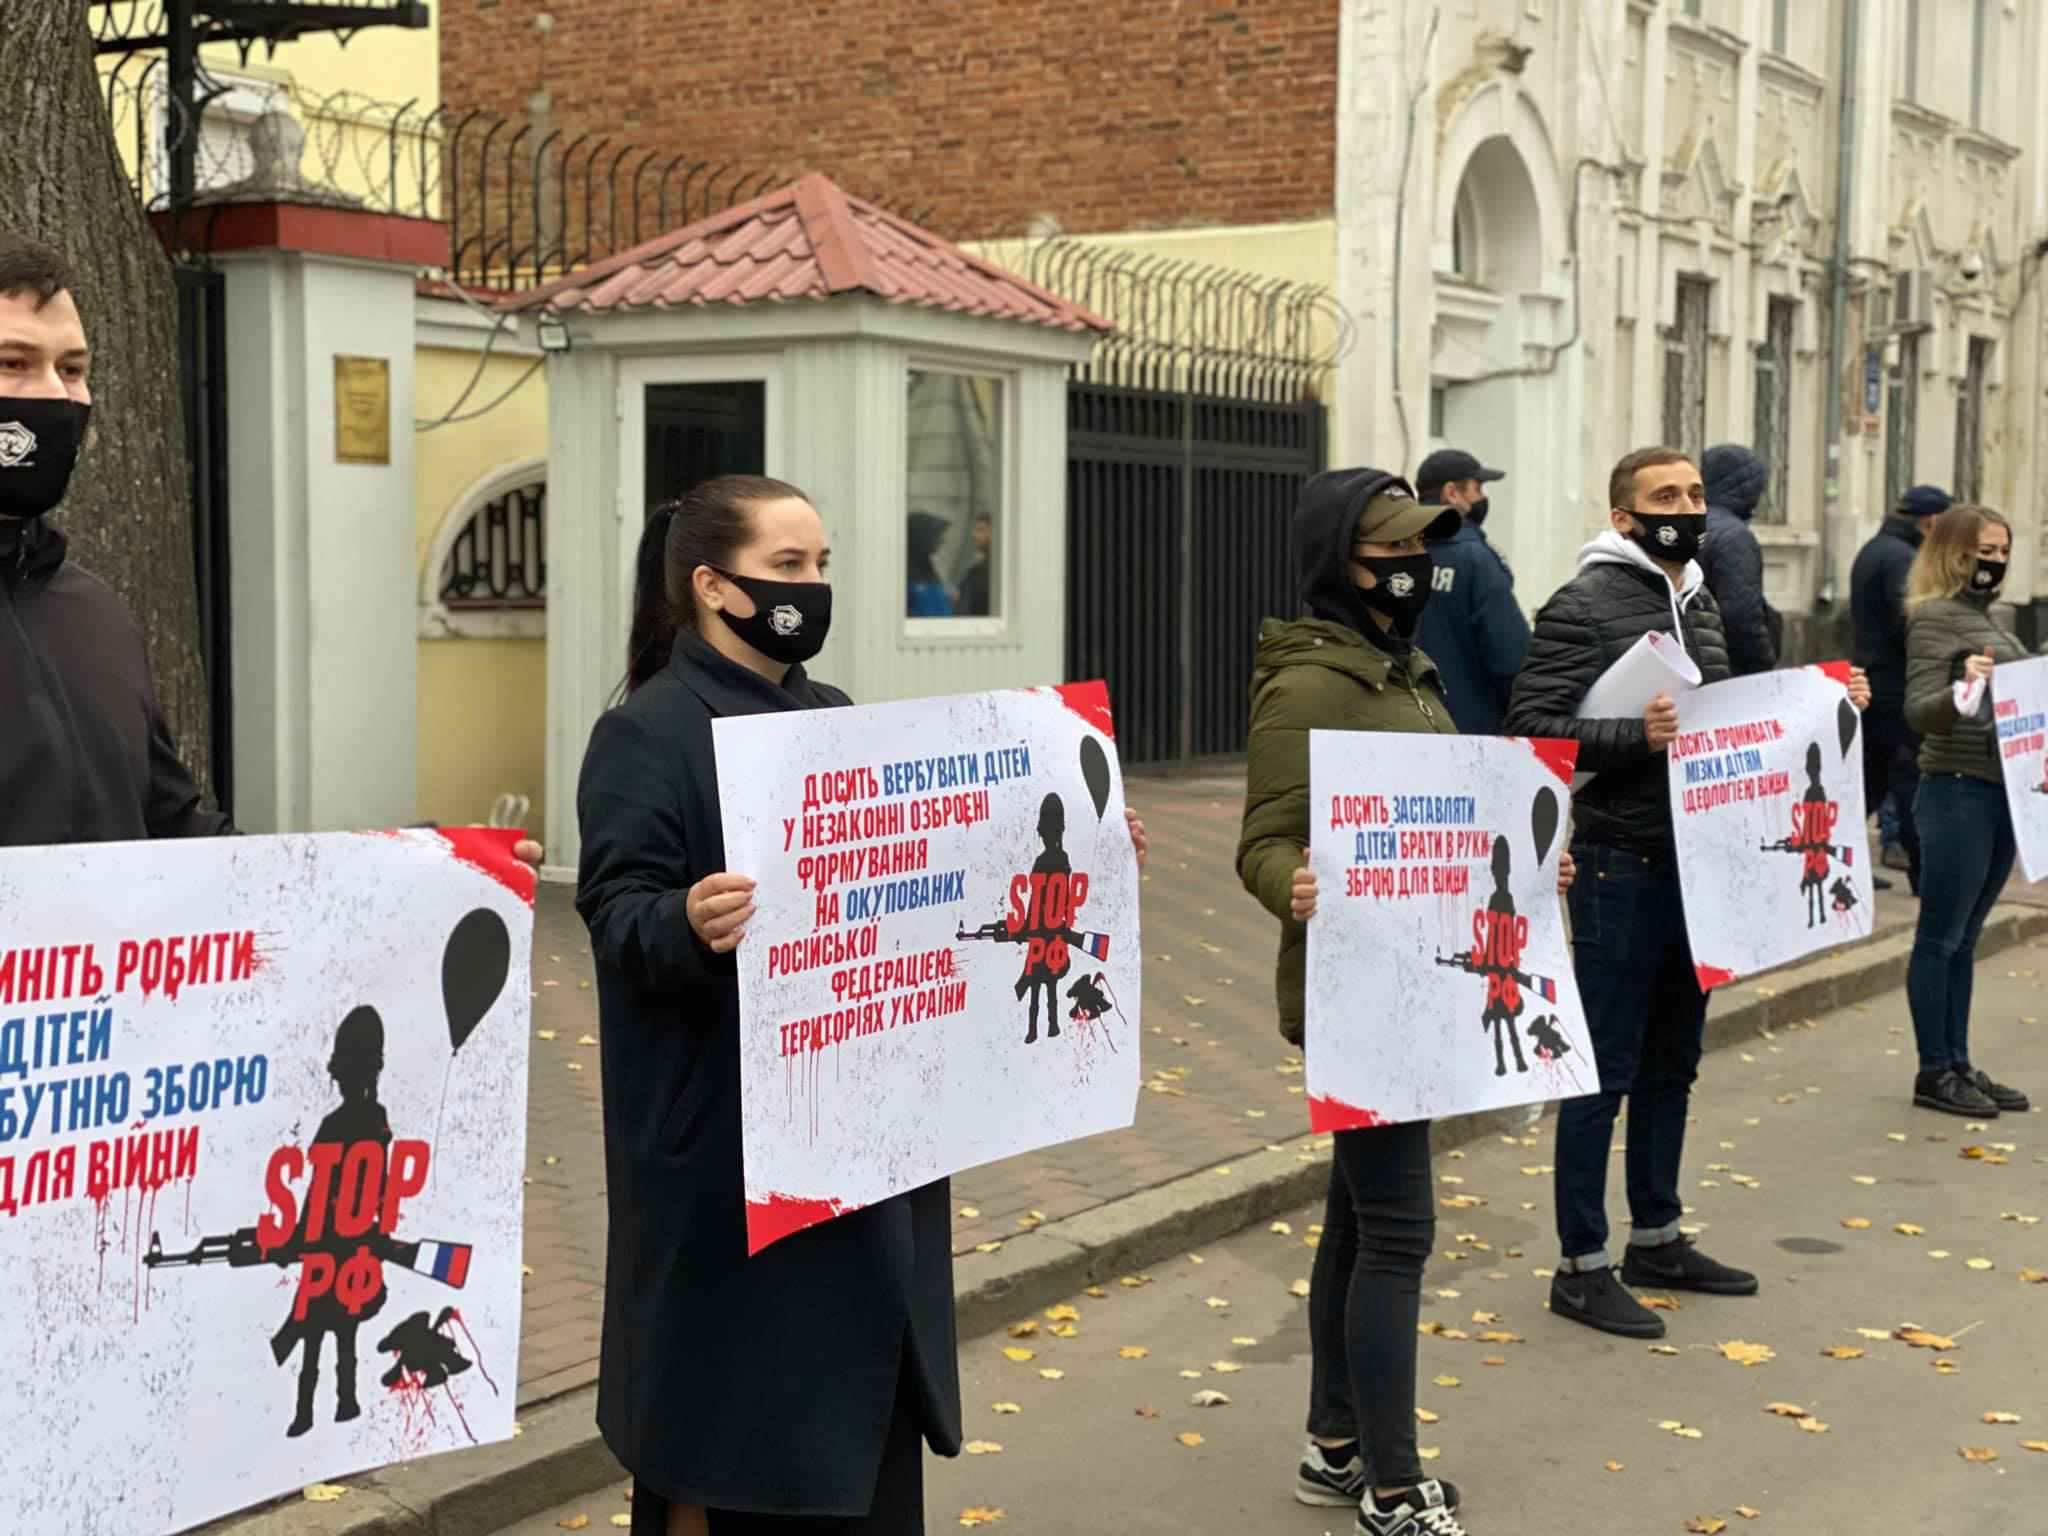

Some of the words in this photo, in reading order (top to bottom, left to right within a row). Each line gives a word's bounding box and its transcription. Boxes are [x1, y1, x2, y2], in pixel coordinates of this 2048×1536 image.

[1671, 731, 1714, 763] ДОСИТЬ
[1714, 720, 1782, 750] ПРОМИВАТИ
[1685, 756, 1724, 784] МІЗКИ
[1725, 748, 1763, 779] ДІТЯМ
[802, 767, 879, 812] ДОСИТЬ
[883, 753, 979, 797] ВЕРБУВАТИ
[984, 740, 1032, 786] ДІТЕЙ
[1758, 768, 1790, 797] ВІЙНИ
[783, 818, 796, 852] У
[802, 802, 905, 849] НЕЗАКОННІ
[910, 790, 990, 832] ОЗБРОЄНІ
[1331, 794, 1389, 831] ДОСИТЬ
[1393, 795, 1476, 824] ЗАСТАВЛЯТИ
[1791, 800, 1838, 847] STOP
[797, 838, 928, 890] ФОРМУВАННЯ
[1355, 824, 1397, 865] ДІТЕЙ
[1400, 831, 1442, 860] БРАТИ
[1445, 831, 1454, 860] В
[1457, 831, 1489, 859] РУКИ
[1804, 848, 1828, 879] РФ
[815, 892, 840, 927] НА
[846, 870, 966, 922] ОКУПОВАНИХ
[1006, 872, 1089, 934] STOP
[1345, 867, 1394, 900] ЗБРОЮ
[1398, 866, 1430, 899] ДЛЯ
[1432, 863, 1469, 896] ВІЙНИ
[115, 930, 256, 1001] РОБИТИ
[768, 916, 881, 979] РОСІЙСЬКОЇ
[1025, 934, 1069, 976] РФ
[1471, 908, 1529, 969] STOP
[831, 947, 954, 1003] ФЕДЕРАЦІЄЮ
[1488, 970, 1521, 1012] РФ
[0, 995, 113, 1081] ДІТЕЙ
[780, 999, 884, 1057] ТЕРИТОРІЯХ
[890, 980, 967, 1029] УКРАЇНИ
[0, 1071, 131, 1143] БУТНЮ
[141, 1053, 269, 1119] ЗБОРЮ
[0, 1145, 77, 1217] ДЛЯ
[86, 1121, 200, 1200] ВІЙНИ
[255, 1138, 431, 1251] STOP
[293, 1244, 384, 1322] РФ
